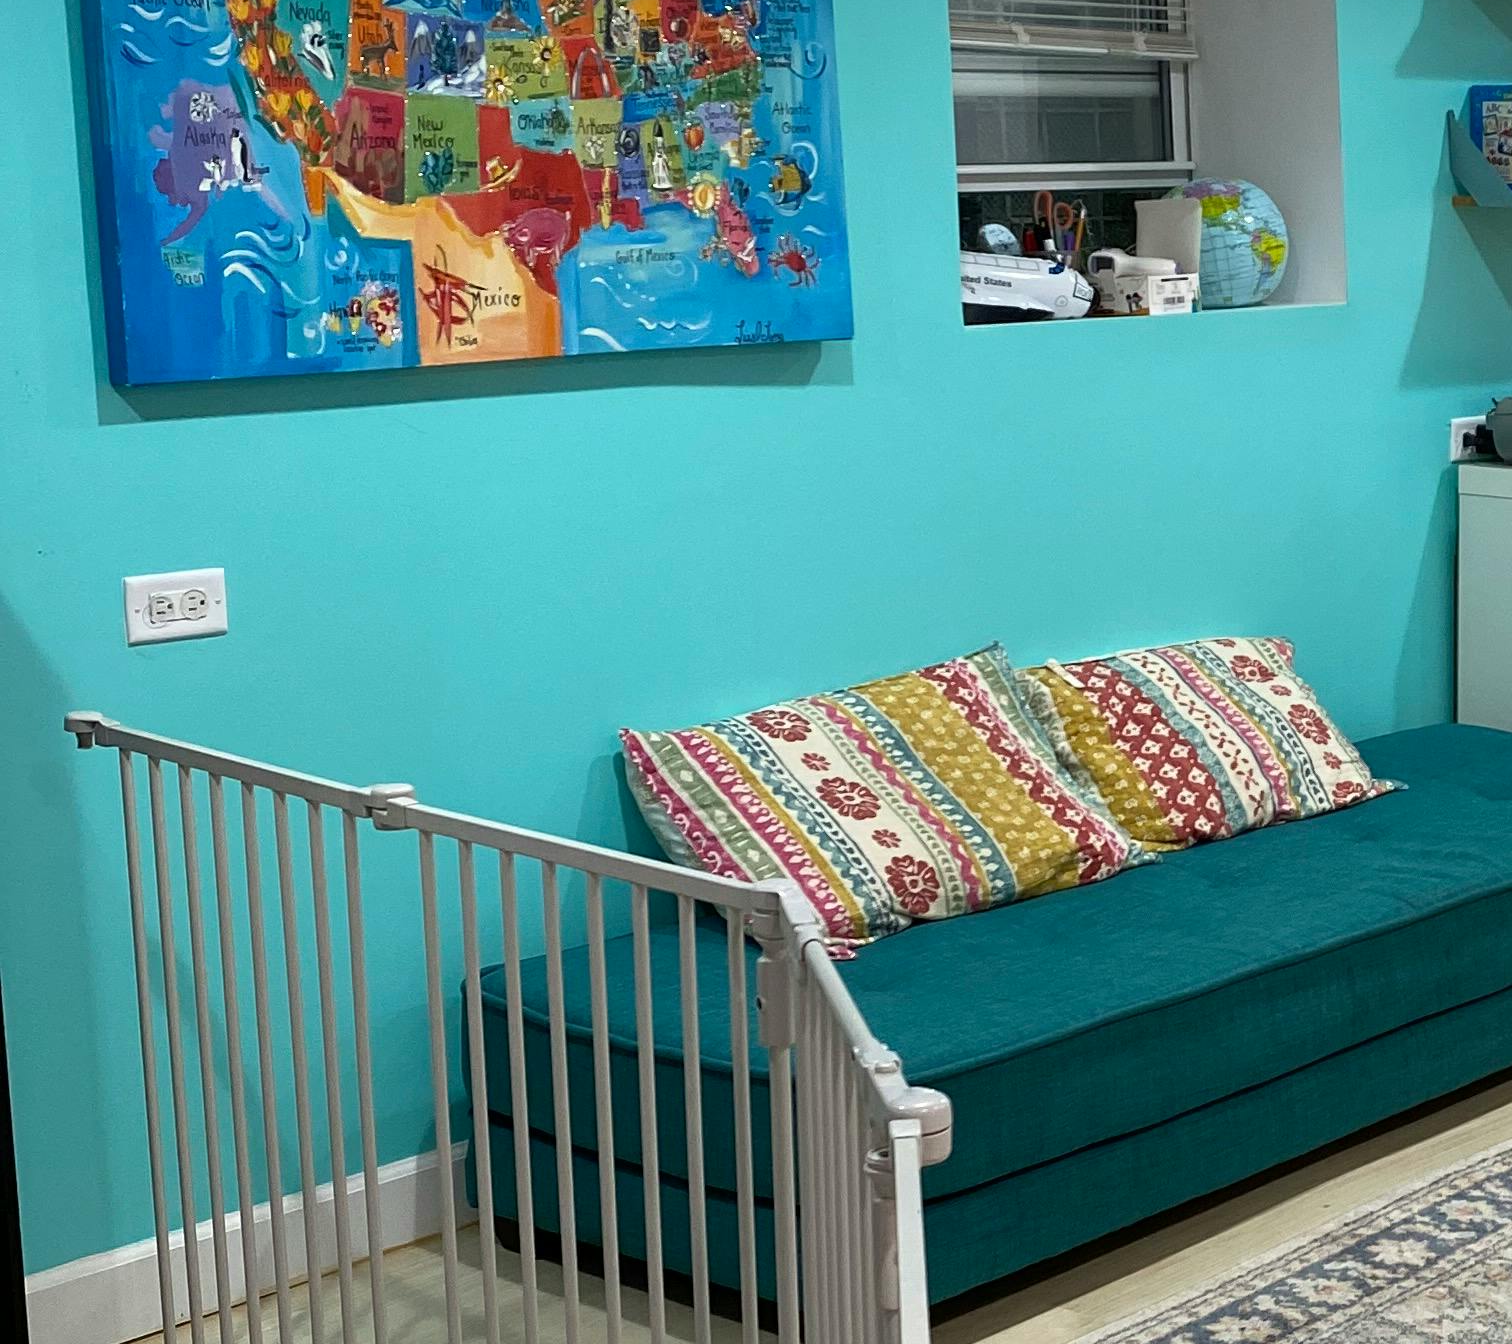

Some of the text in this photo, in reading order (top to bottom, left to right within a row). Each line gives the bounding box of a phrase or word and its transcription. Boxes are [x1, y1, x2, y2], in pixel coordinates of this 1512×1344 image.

[289, 2, 332, 26] Nevada
[358, 25, 384, 43] Utah
[418, 115, 443, 131] New
[184, 127, 226, 149] Alaska
[350, 123, 397, 152] Arizona
[413, 133, 456, 150] Mexico
[616, 248, 635, 264] Gulf
[646, 248, 676, 263] Mexico
[175, 273, 205, 287] Ocean
[961, 275, 1012, 288] ited States
[471, 286, 521, 312] Mexico
